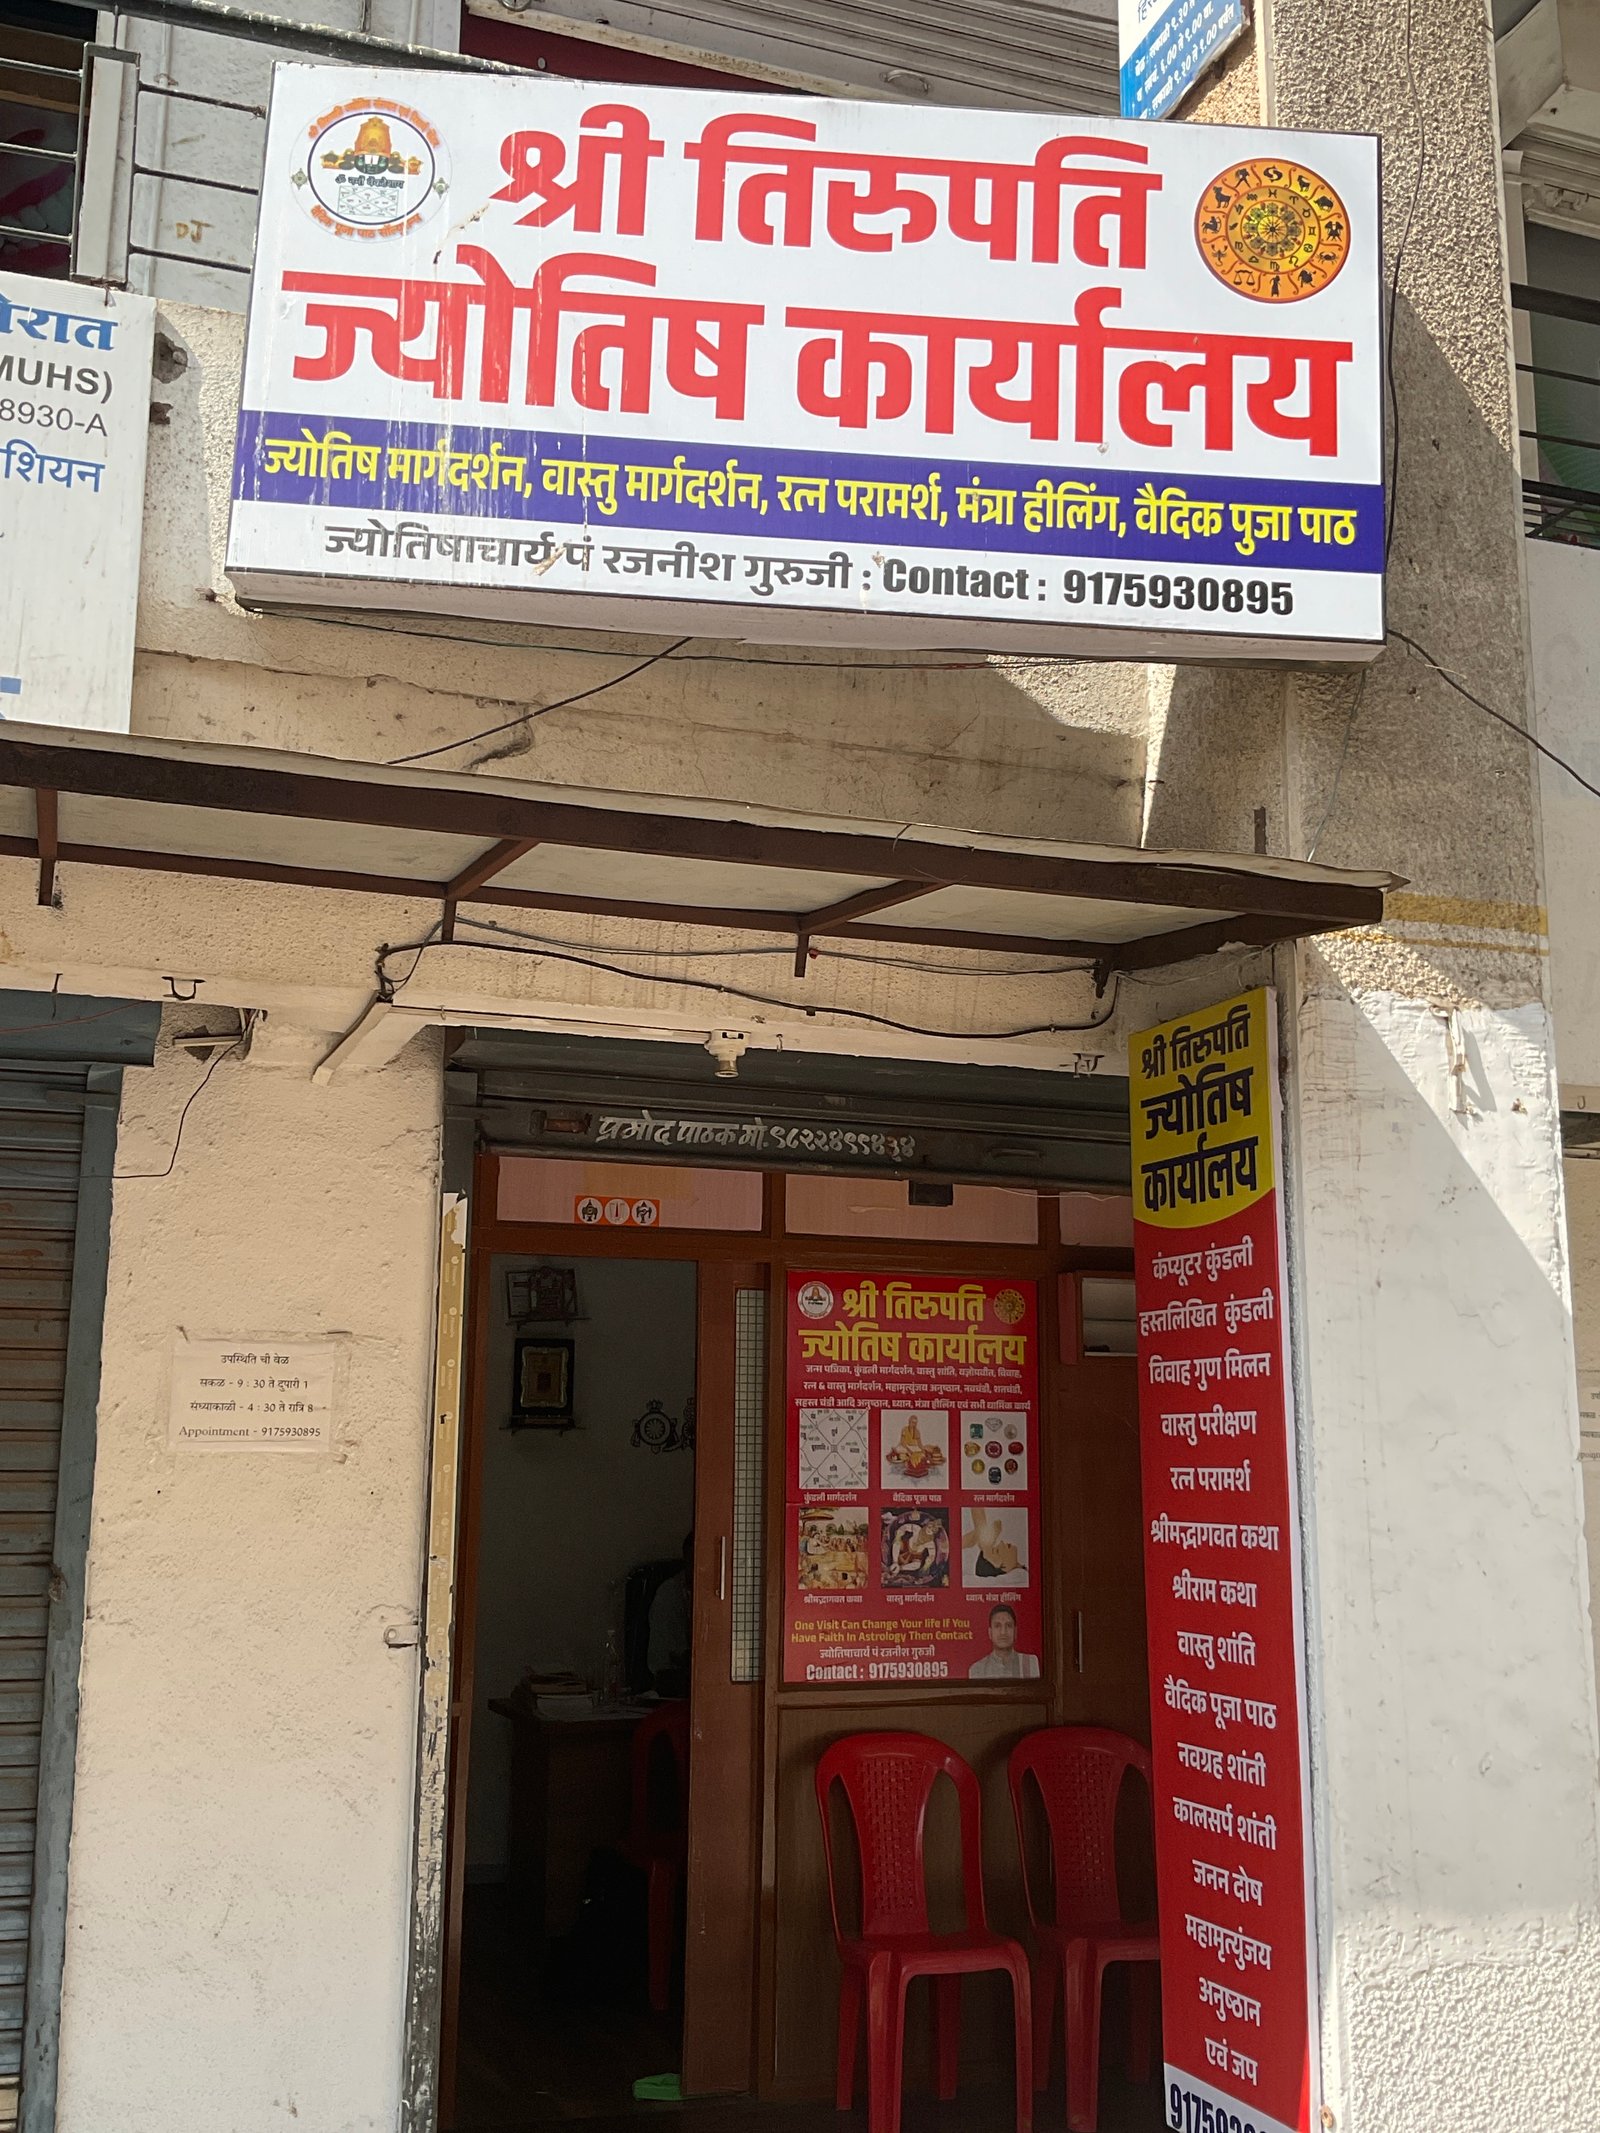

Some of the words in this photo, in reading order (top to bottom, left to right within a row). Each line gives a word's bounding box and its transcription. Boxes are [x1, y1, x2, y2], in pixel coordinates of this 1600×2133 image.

[488, 103, 665, 238] श्री
[683, 113, 1163, 270] तिरुपति
[281, 243, 765, 422] ज्योतिष
[785, 287, 1353, 458] कार्यालय
[264, 428, 381, 481] ज्योतिष
[387, 438, 533, 499] मार्गदर्शन,
[541, 459, 619, 516] वास्तु
[624, 455, 769, 516] मार्गदर्शन,
[777, 475, 829, 514] रत्न
[834, 472, 948, 527] परामर्श,
[956, 476, 1017, 526] मंत्रा
[1022, 479, 1127, 538] हीलिंग,
[1133, 482, 1224, 539] वैदिक
[1229, 503, 1292, 556] पुजा
[1298, 506, 1357, 546] पाठ
[324, 518, 555, 566] ज्योतिषाचार्य
[563, 535, 595, 572] पं
[602, 541, 736, 594] रजनीश
[744, 550, 853, 597] गुरुजी
[883, 558, 1030, 600] Contact
[1063, 569, 1294, 616] 9175930895
[1141, 1034, 1167, 1079] श्री
[1170, 1004, 1251, 1071] तिरुपति
[1140, 1063, 1254, 1140] ज्योतिष
[596, 1109, 676, 1145] प्रमोद
[676, 1120, 740, 1146] पाठक
[1141, 1132, 1259, 1212] कार्यालय
[1205, 1234, 1253, 1282] कुंडली
[842, 1280, 878, 1318] श्री
[883, 1281, 986, 1322] तिरुपति
[1139, 1298, 1217, 1337] हस्तलिखित
[1223, 1287, 1274, 1334] कुंडली
[221, 1353, 257, 1364] उपस्थिति
[260, 1353, 271, 1364] ची
[273, 1353, 290, 1365] वेळ
[798, 1321, 902, 1362] ज्योतिष
[906, 1325, 1027, 1365] कार्यालय
[253, 1379, 266, 1389] 30
[277, 1377, 300, 1392] दुपारी
[818, 1382, 826, 1391] &
[1149, 1354, 1191, 1385] विवाह
[1193, 1357, 1222, 1391] गुण
[1225, 1348, 1271, 1379] मिलन
[247, 1403, 254, 1412] 4
[264, 1403, 276, 1413] 30
[307, 1404, 314, 1413] 8
[1161, 1413, 1198, 1446] वास्तु
[1200, 1404, 1257, 1438] परीक्षण
[178, 1426, 250, 1438] Appointment
[261, 1427, 321, 1437] 9175930895
[1170, 1467, 1195, 1490] रत्न
[1197, 1459, 1251, 1492] परामर्श
[1150, 1512, 1238, 1550] श्रीमद्भागवत
[1240, 1524, 1279, 1550] कथा
[1172, 1568, 1217, 1603] श्रीराम
[1219, 1580, 1257, 1608] कथा
[791, 1633, 816, 1644] Have
[818, 1632, 844, 1643] Faith
[847, 1632, 857, 1642] In
[858, 1631, 907, 1644] Astrology
[909, 1631, 933, 1641] Then
[935, 1630, 973, 1641] Contact
[795, 1620, 814, 1631] One
[816, 1619, 839, 1631] Visit
[842, 1620, 859, 1630] Can
[862, 1619, 898, 1632] Change
[900, 1619, 923, 1630] Your
[952, 1618, 970, 1629] You
[806, 1663, 858, 1681] Contact
[868, 1661, 948, 1680] 9175930895
[880, 1645, 910, 1659] रजनीश
[911, 1644, 936, 1661] गुरुजी
[1177, 1630, 1215, 1670] वास्तु
[1217, 1631, 1256, 1666] शांति
[1163, 1674, 1207, 1715] वैदिक
[1209, 1692, 1241, 1730] पूजा
[1244, 1699, 1277, 1729] पाठ
[1177, 1741, 1224, 1780] नवग्रह
[1227, 1749, 1266, 1787] शांती
[1172, 1796, 1233, 1838] कालसर्प
[1237, 1810, 1277, 1851] शांती
[1192, 1859, 1230, 1895] जनन
[1232, 1865, 1263, 1907] दोष
[1184, 1913, 1272, 1971] महामृत्युंजय
[1199, 1976, 1261, 2027] अनुष्ठान
[1205, 2037, 1228, 2071] एवं
[1230, 2049, 1258, 2087] जप
